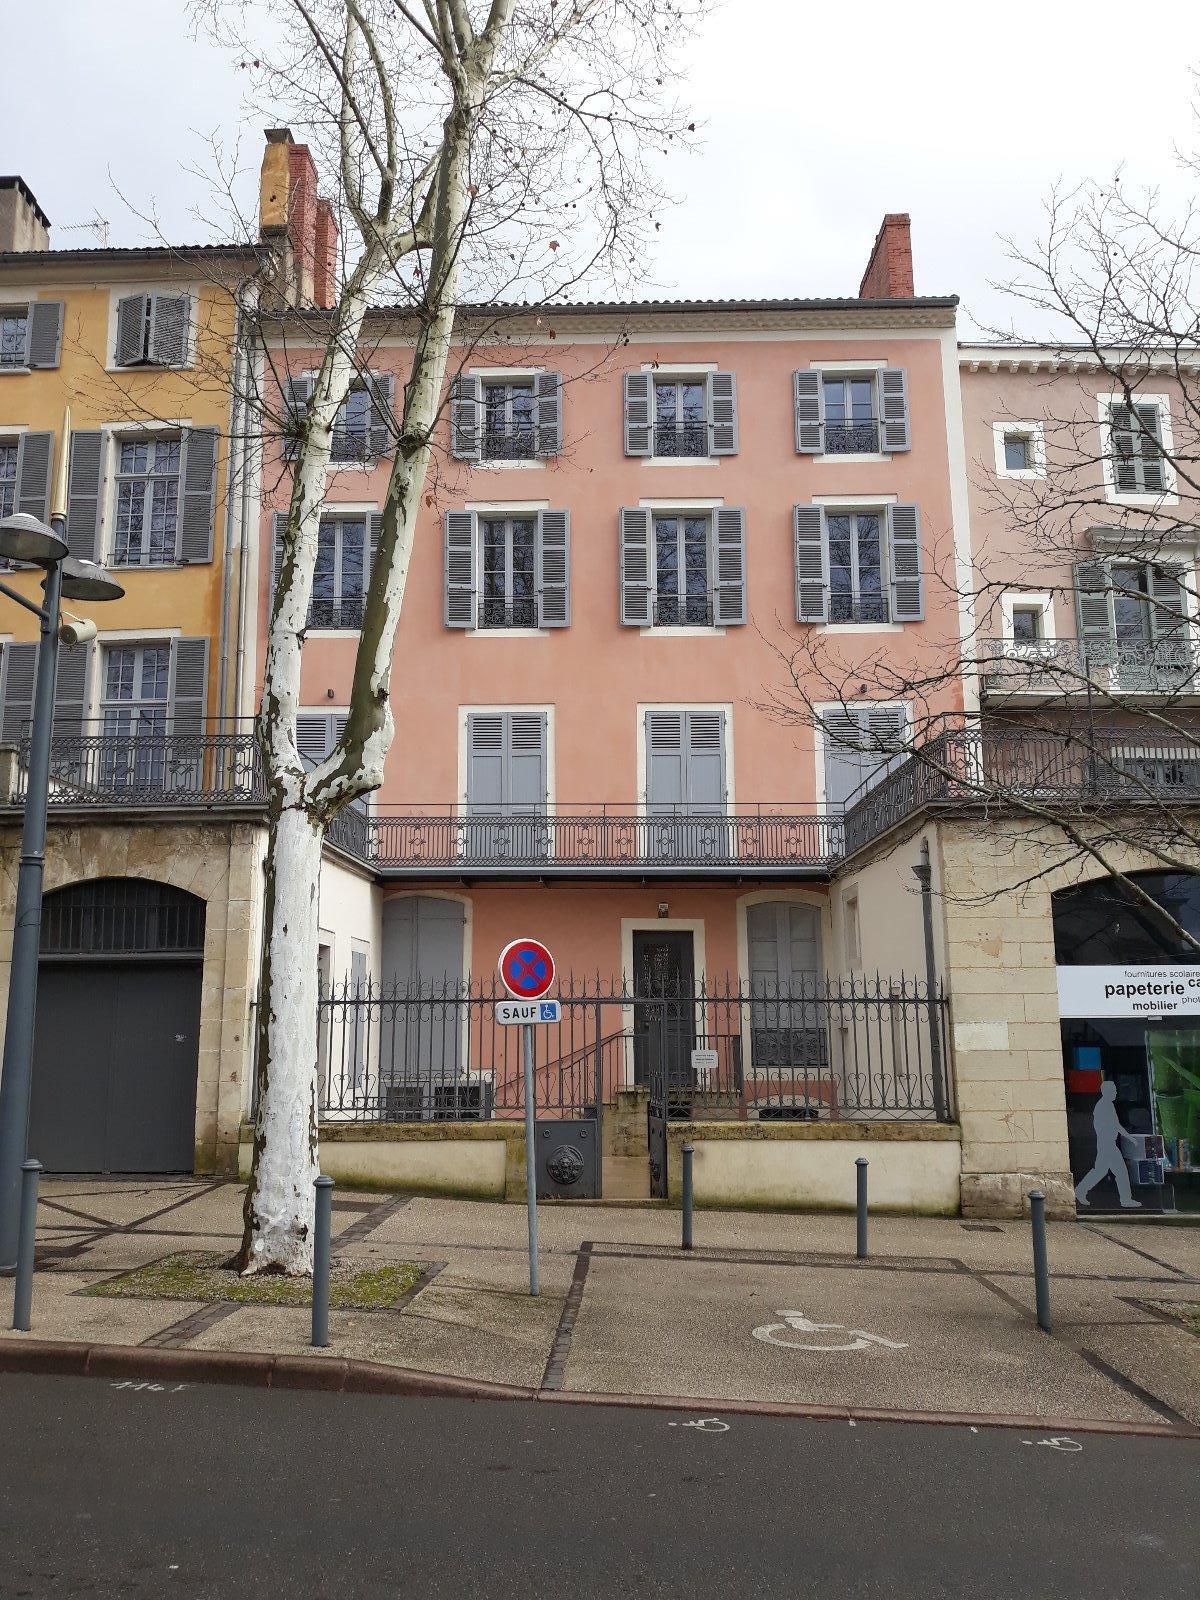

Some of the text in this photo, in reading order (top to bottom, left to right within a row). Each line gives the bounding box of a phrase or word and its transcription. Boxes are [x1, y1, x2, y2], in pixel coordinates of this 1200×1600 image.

[1124, 970, 1200, 978] fournitures scolaire
[1104, 980, 1185, 998] papeterie
[1132, 1001, 1178, 1010] mobilier
[503, 1007, 537, 1019] SAUF
